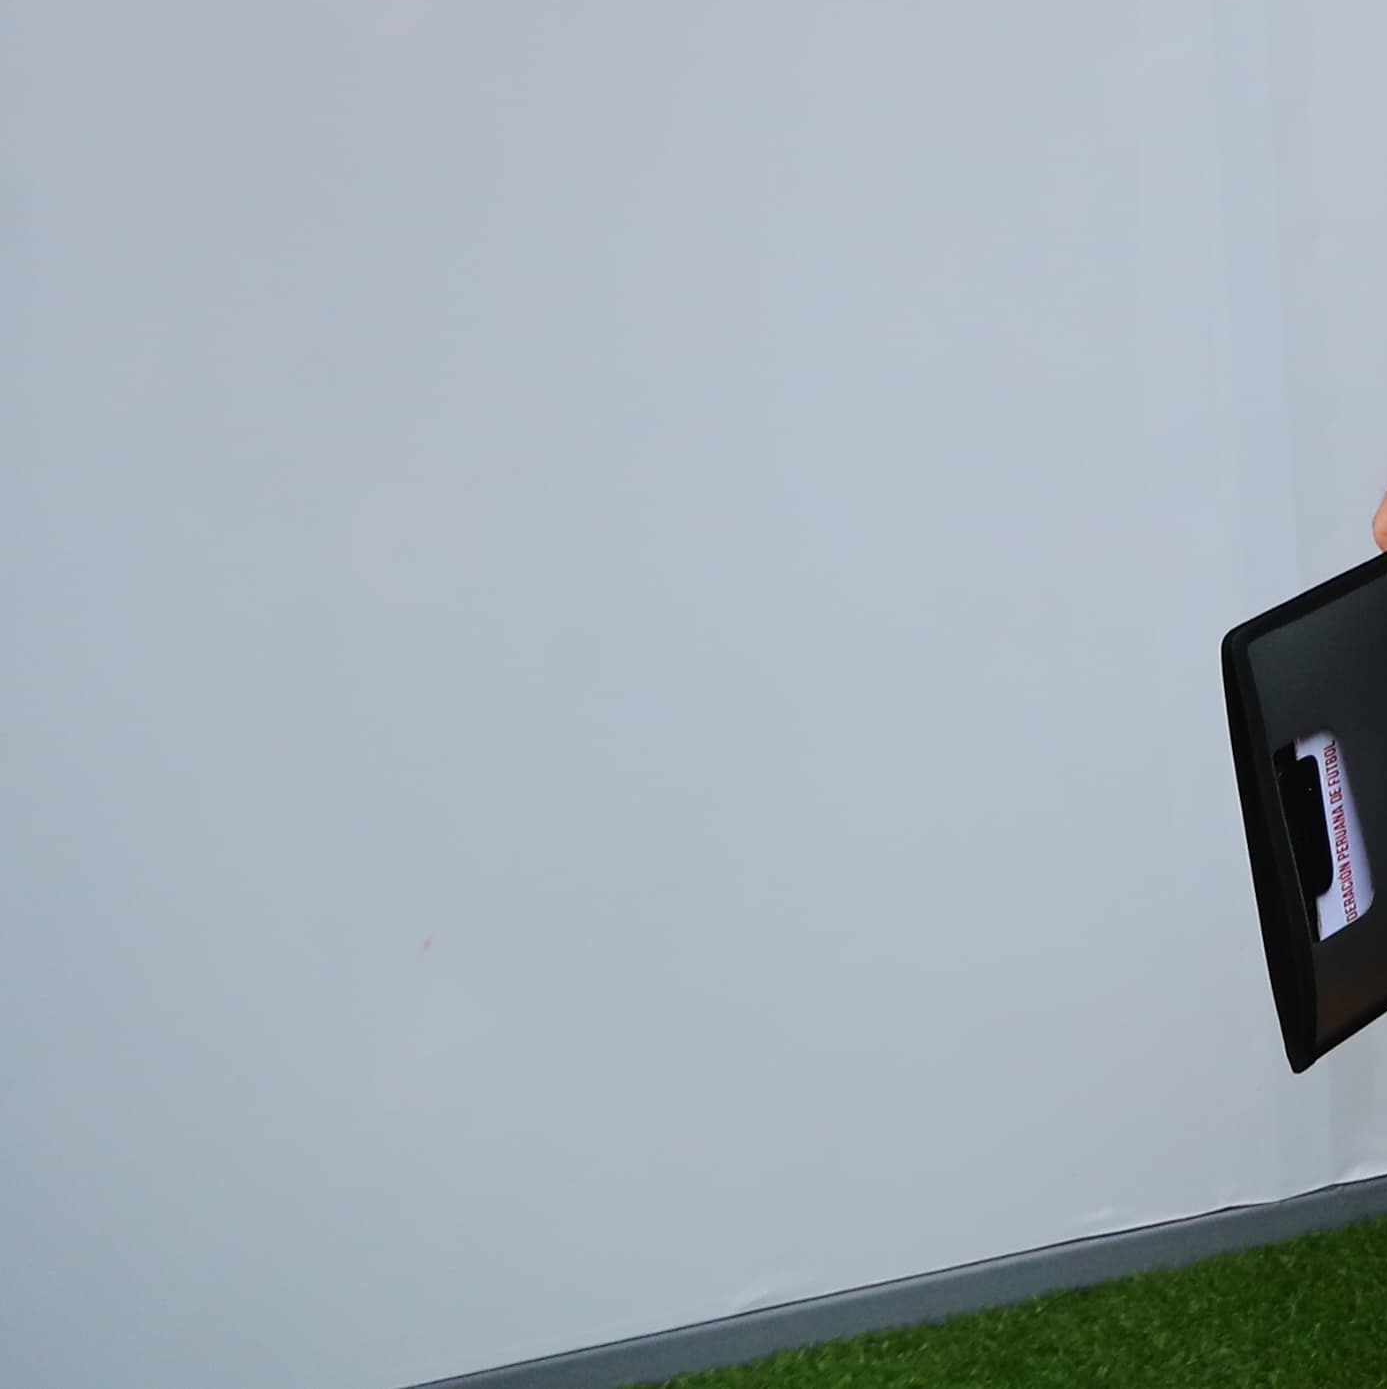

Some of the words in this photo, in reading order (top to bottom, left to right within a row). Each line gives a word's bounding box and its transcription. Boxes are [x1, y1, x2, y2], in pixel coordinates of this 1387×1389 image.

[1328, 786, 1343, 805] DE
[1331, 804, 1349, 862] PERUANA
[1339, 861, 1359, 924] DERACIÓN
